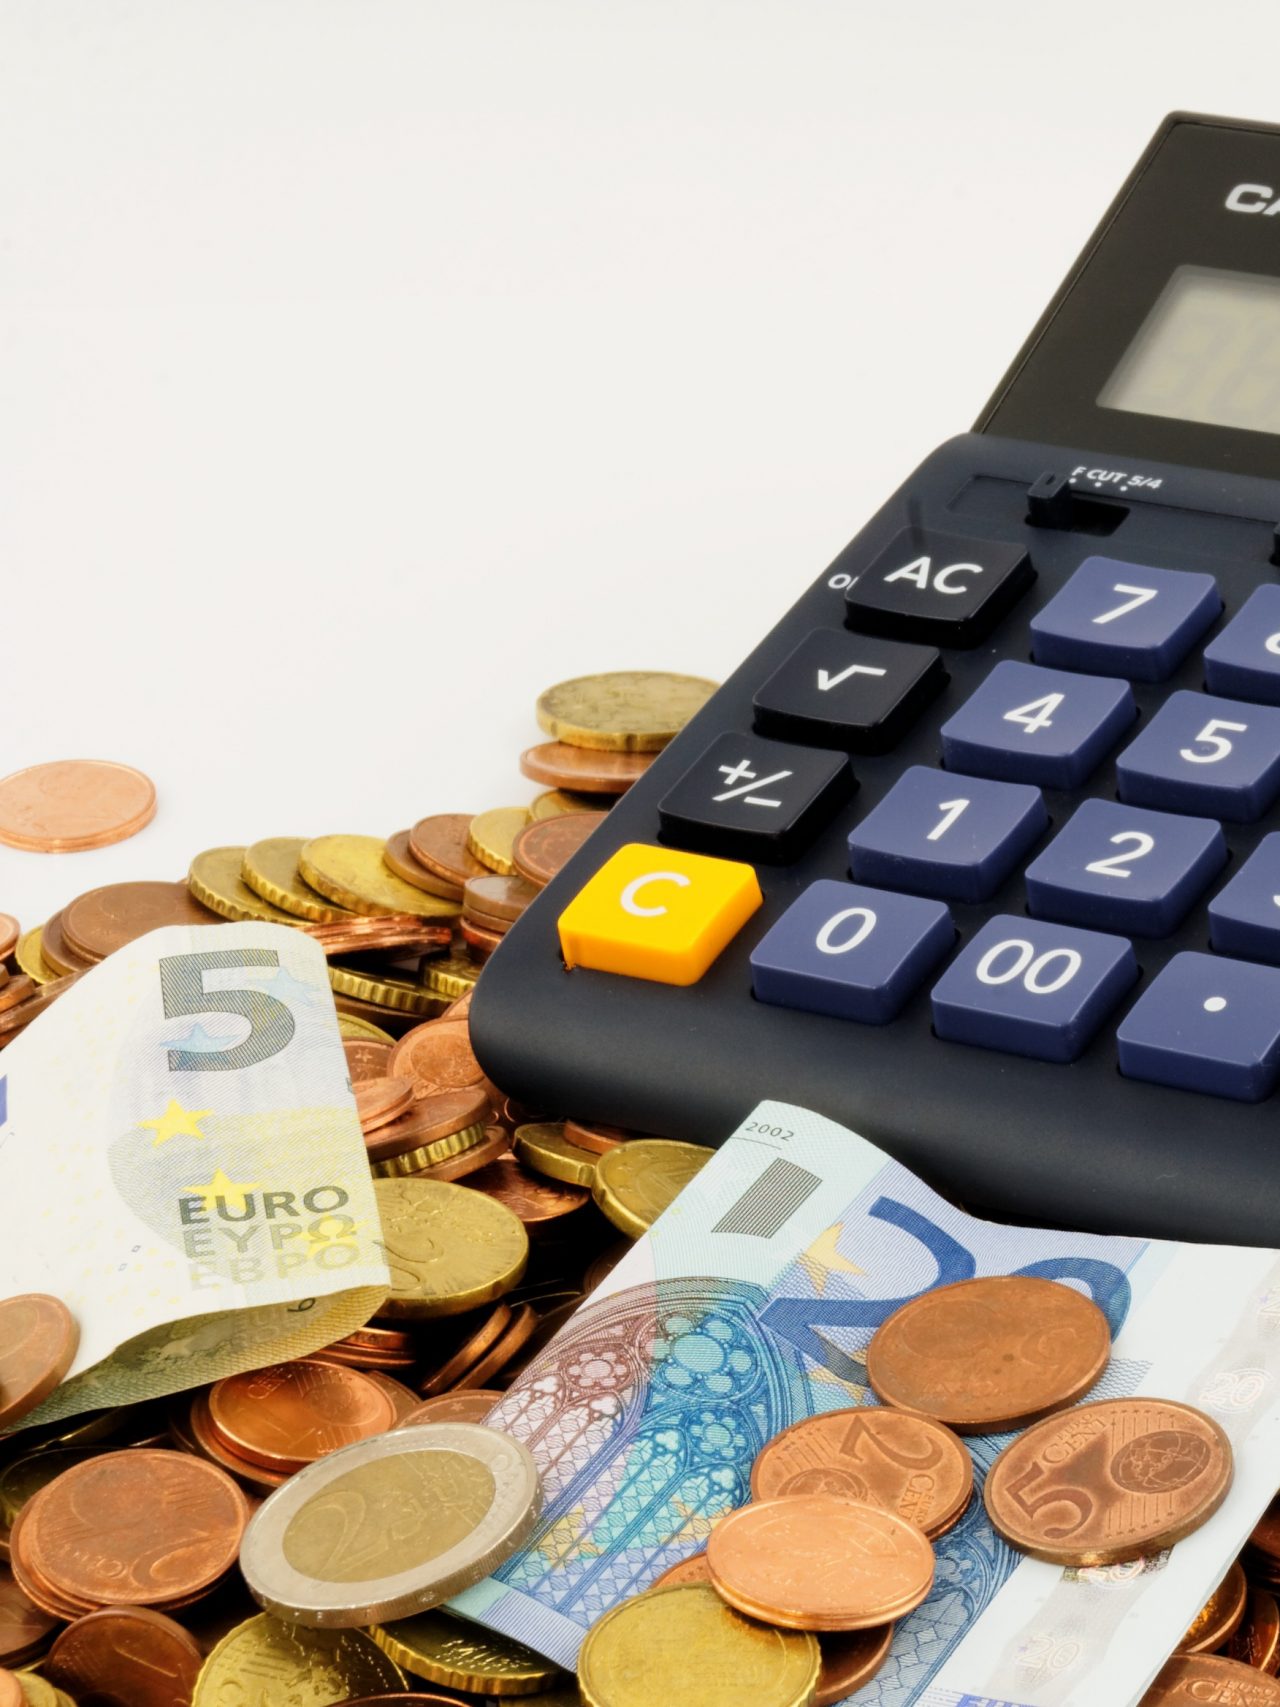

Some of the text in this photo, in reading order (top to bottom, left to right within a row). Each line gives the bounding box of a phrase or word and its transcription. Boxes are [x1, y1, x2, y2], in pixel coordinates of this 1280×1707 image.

[1071, 464, 1164, 490] F CUT 5/4
[883, 556, 984, 595] AC
[1092, 583, 1158, 625] 7
[1003, 692, 1065, 734] 4
[1179, 719, 1248, 764] 5
[926, 798, 970, 841] 1
[1085, 831, 1155, 878] 2
[617, 868, 694, 920] C
[815, 907, 877, 955] 0
[975, 938, 1082, 994] 00
[159, 949, 295, 1072] 5
[745, 1121, 795, 1142] 2002
[178, 1185, 350, 1225] EURO
[1006, 1461, 1093, 1540] 5
